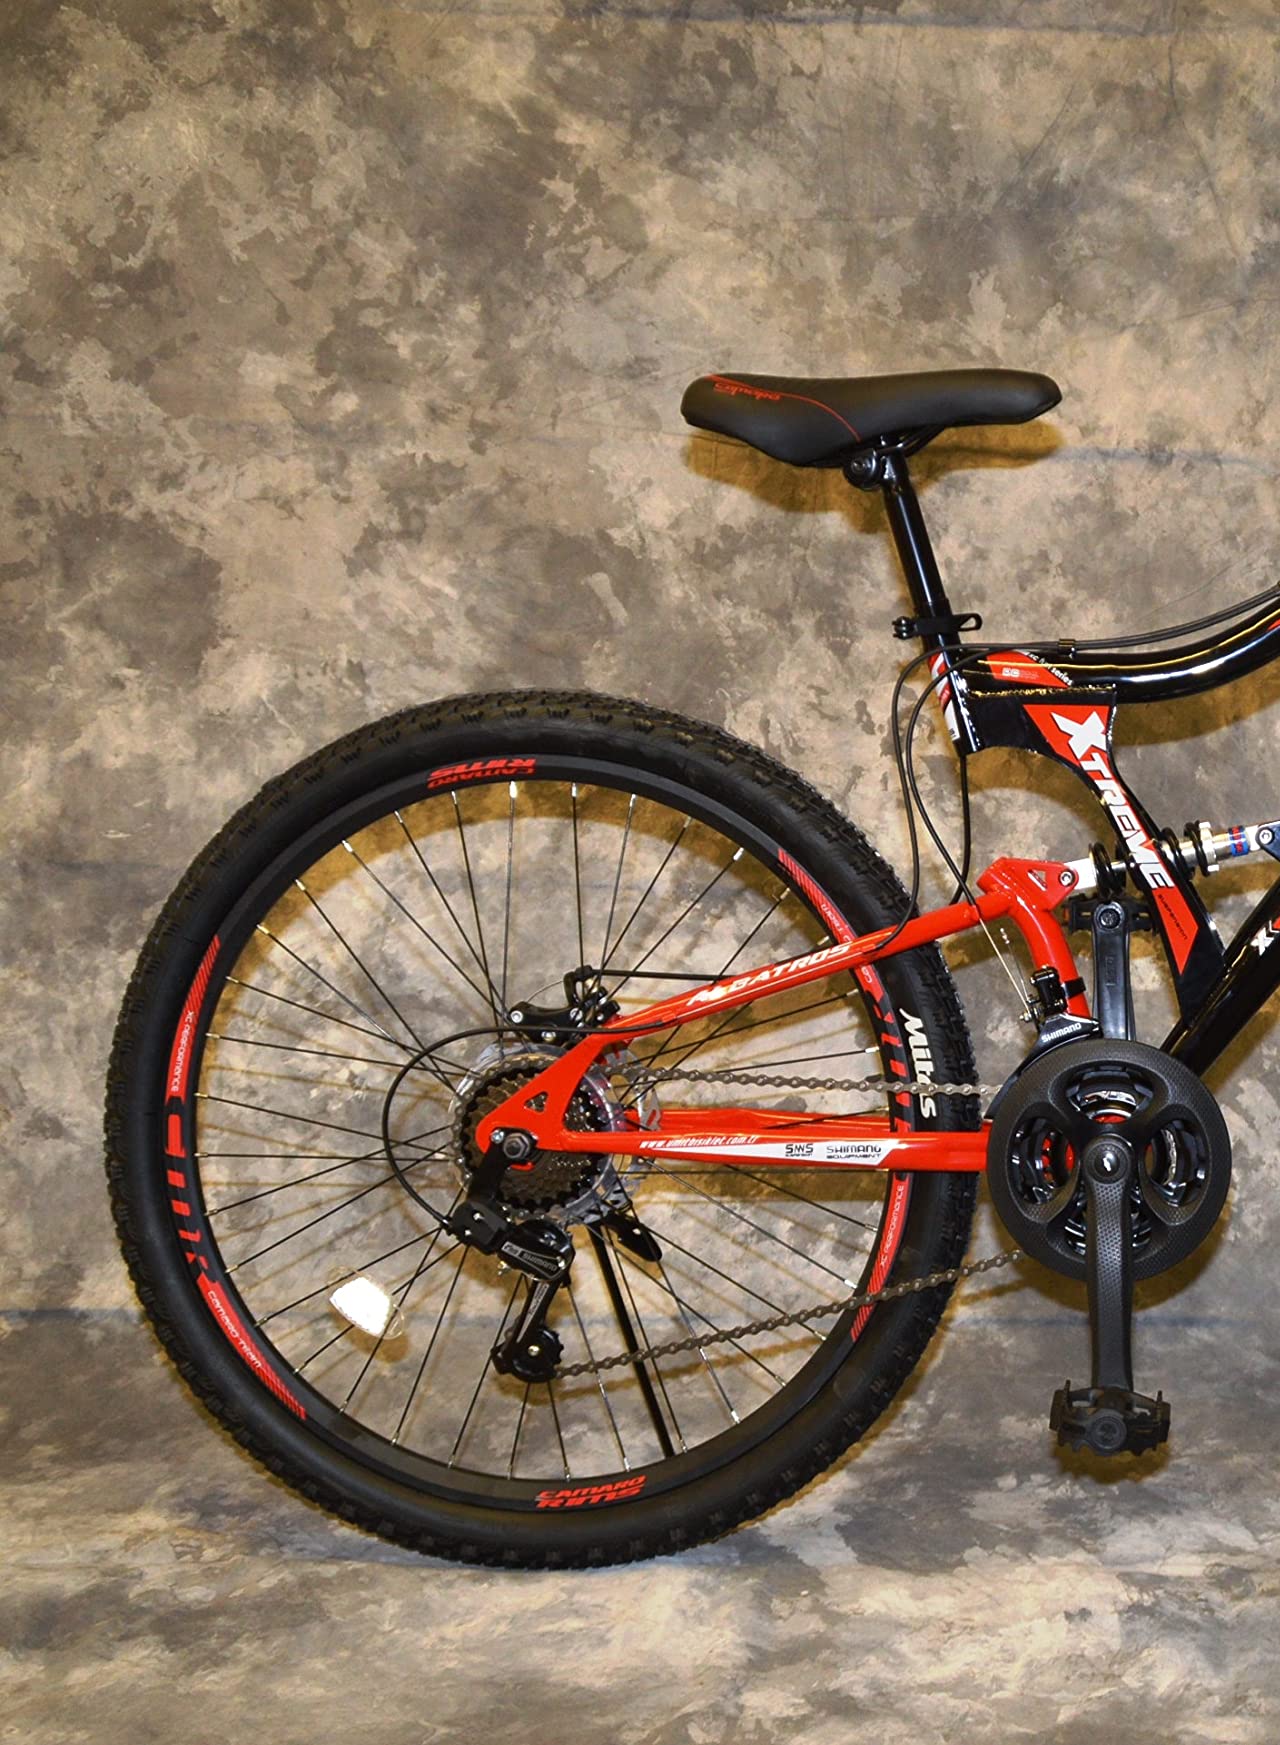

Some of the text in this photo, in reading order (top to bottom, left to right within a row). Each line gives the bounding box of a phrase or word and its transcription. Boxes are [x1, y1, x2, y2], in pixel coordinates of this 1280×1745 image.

[1050, 710, 1176, 889] XTREME
[1041, 1022, 1082, 1042] SHIMANO
[826, 1144, 882, 1153] SHIMANO
[535, 1486, 642, 1509] RIMS
[538, 1475, 647, 1500] CAMARO
